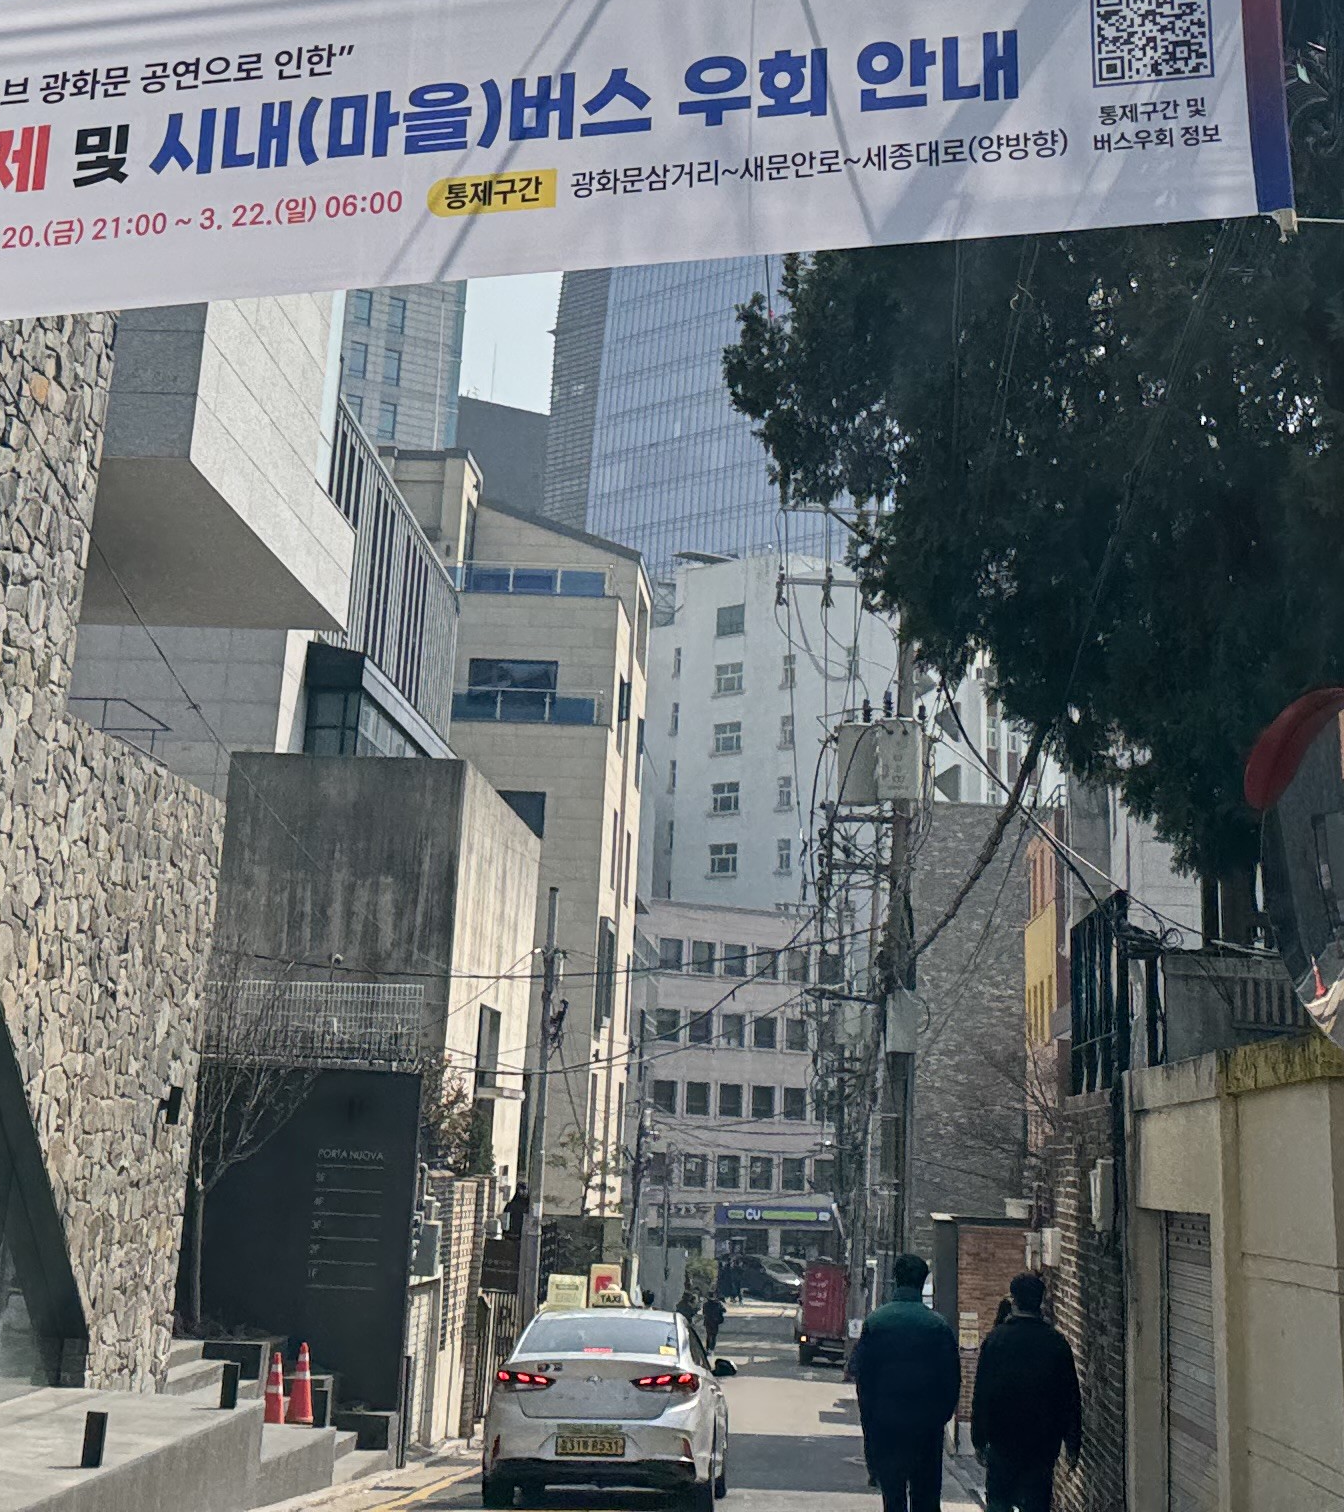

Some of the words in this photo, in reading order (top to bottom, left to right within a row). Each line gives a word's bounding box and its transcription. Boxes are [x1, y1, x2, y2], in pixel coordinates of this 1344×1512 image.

[40, 66, 130, 104] 광화문
[140, 53, 263, 93] 공연으로
[73, 124, 129, 188] 및
[149, 68, 652, 175] 시내(마을)버스
[679, 48, 827, 126] 우회
[857, 29, 1018, 112] 안내
[1099, 100, 1179, 125] 통제구간
[1187, 97, 1206, 118] 및
[1094, 128, 1173, 152] 버스우회
[1181, 125, 1221, 146] 정보
[445, 176, 543, 210] 통제구간
[2, 218, 83, 249] 20.(금)
[92, 213, 166, 240] 21:00
[200, 208, 222, 230] 3.
[232, 196, 316, 227] 22.(일)
[326, 191, 402, 218] 06:00
[745, 1208, 761, 1220] CU
